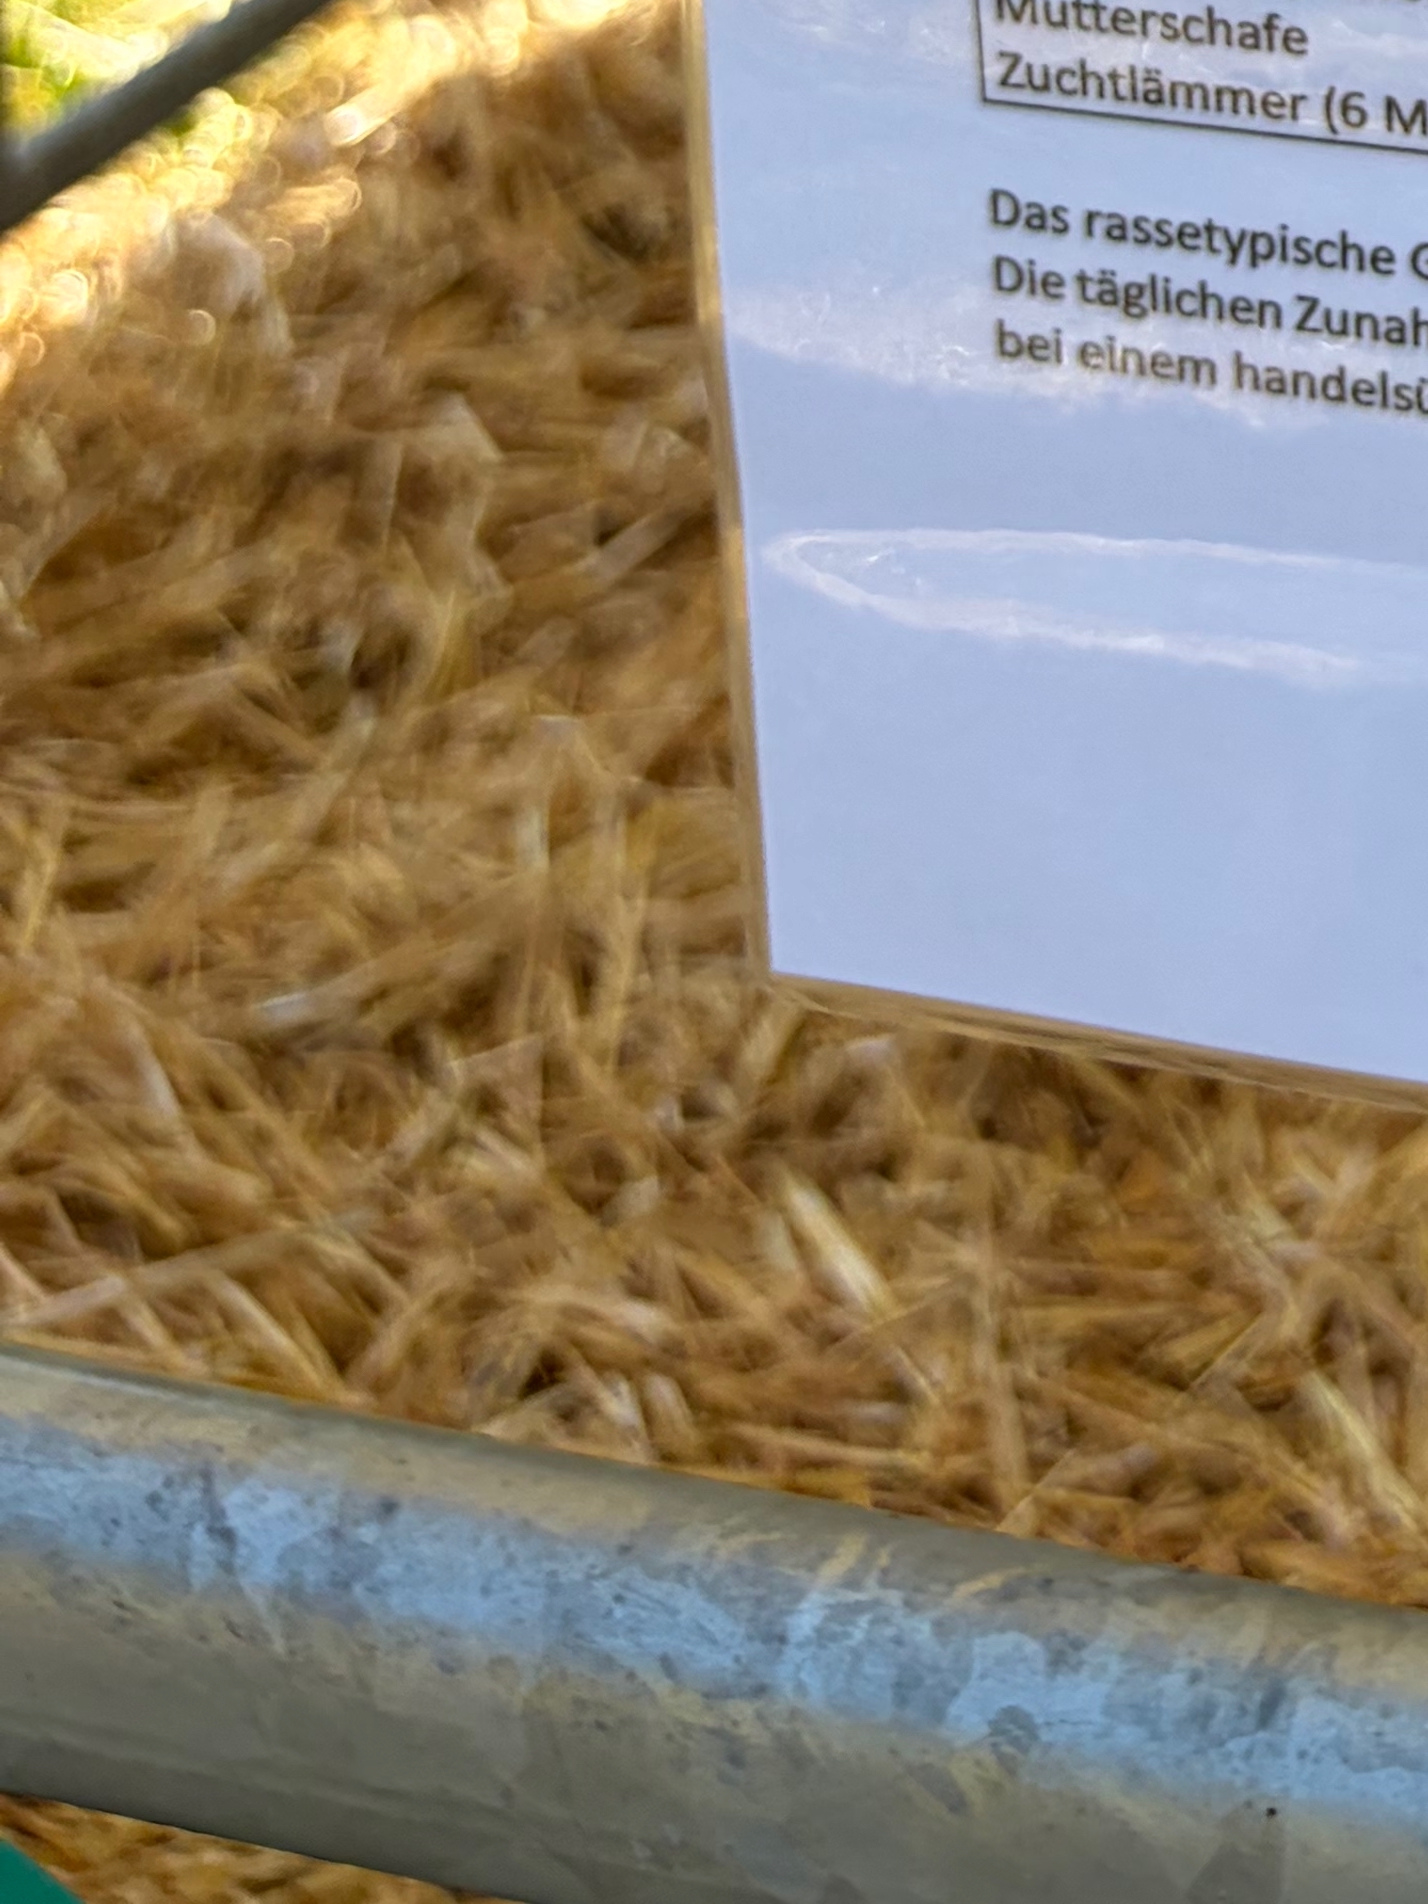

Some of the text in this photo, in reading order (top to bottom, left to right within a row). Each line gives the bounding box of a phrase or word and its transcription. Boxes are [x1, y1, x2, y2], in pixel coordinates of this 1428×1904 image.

[998, 50, 1308, 122] Zuchtlämmer
[1323, 85, 1368, 136] (6
[995, 318, 1062, 364] bei
[1077, 335, 1217, 387] einem
